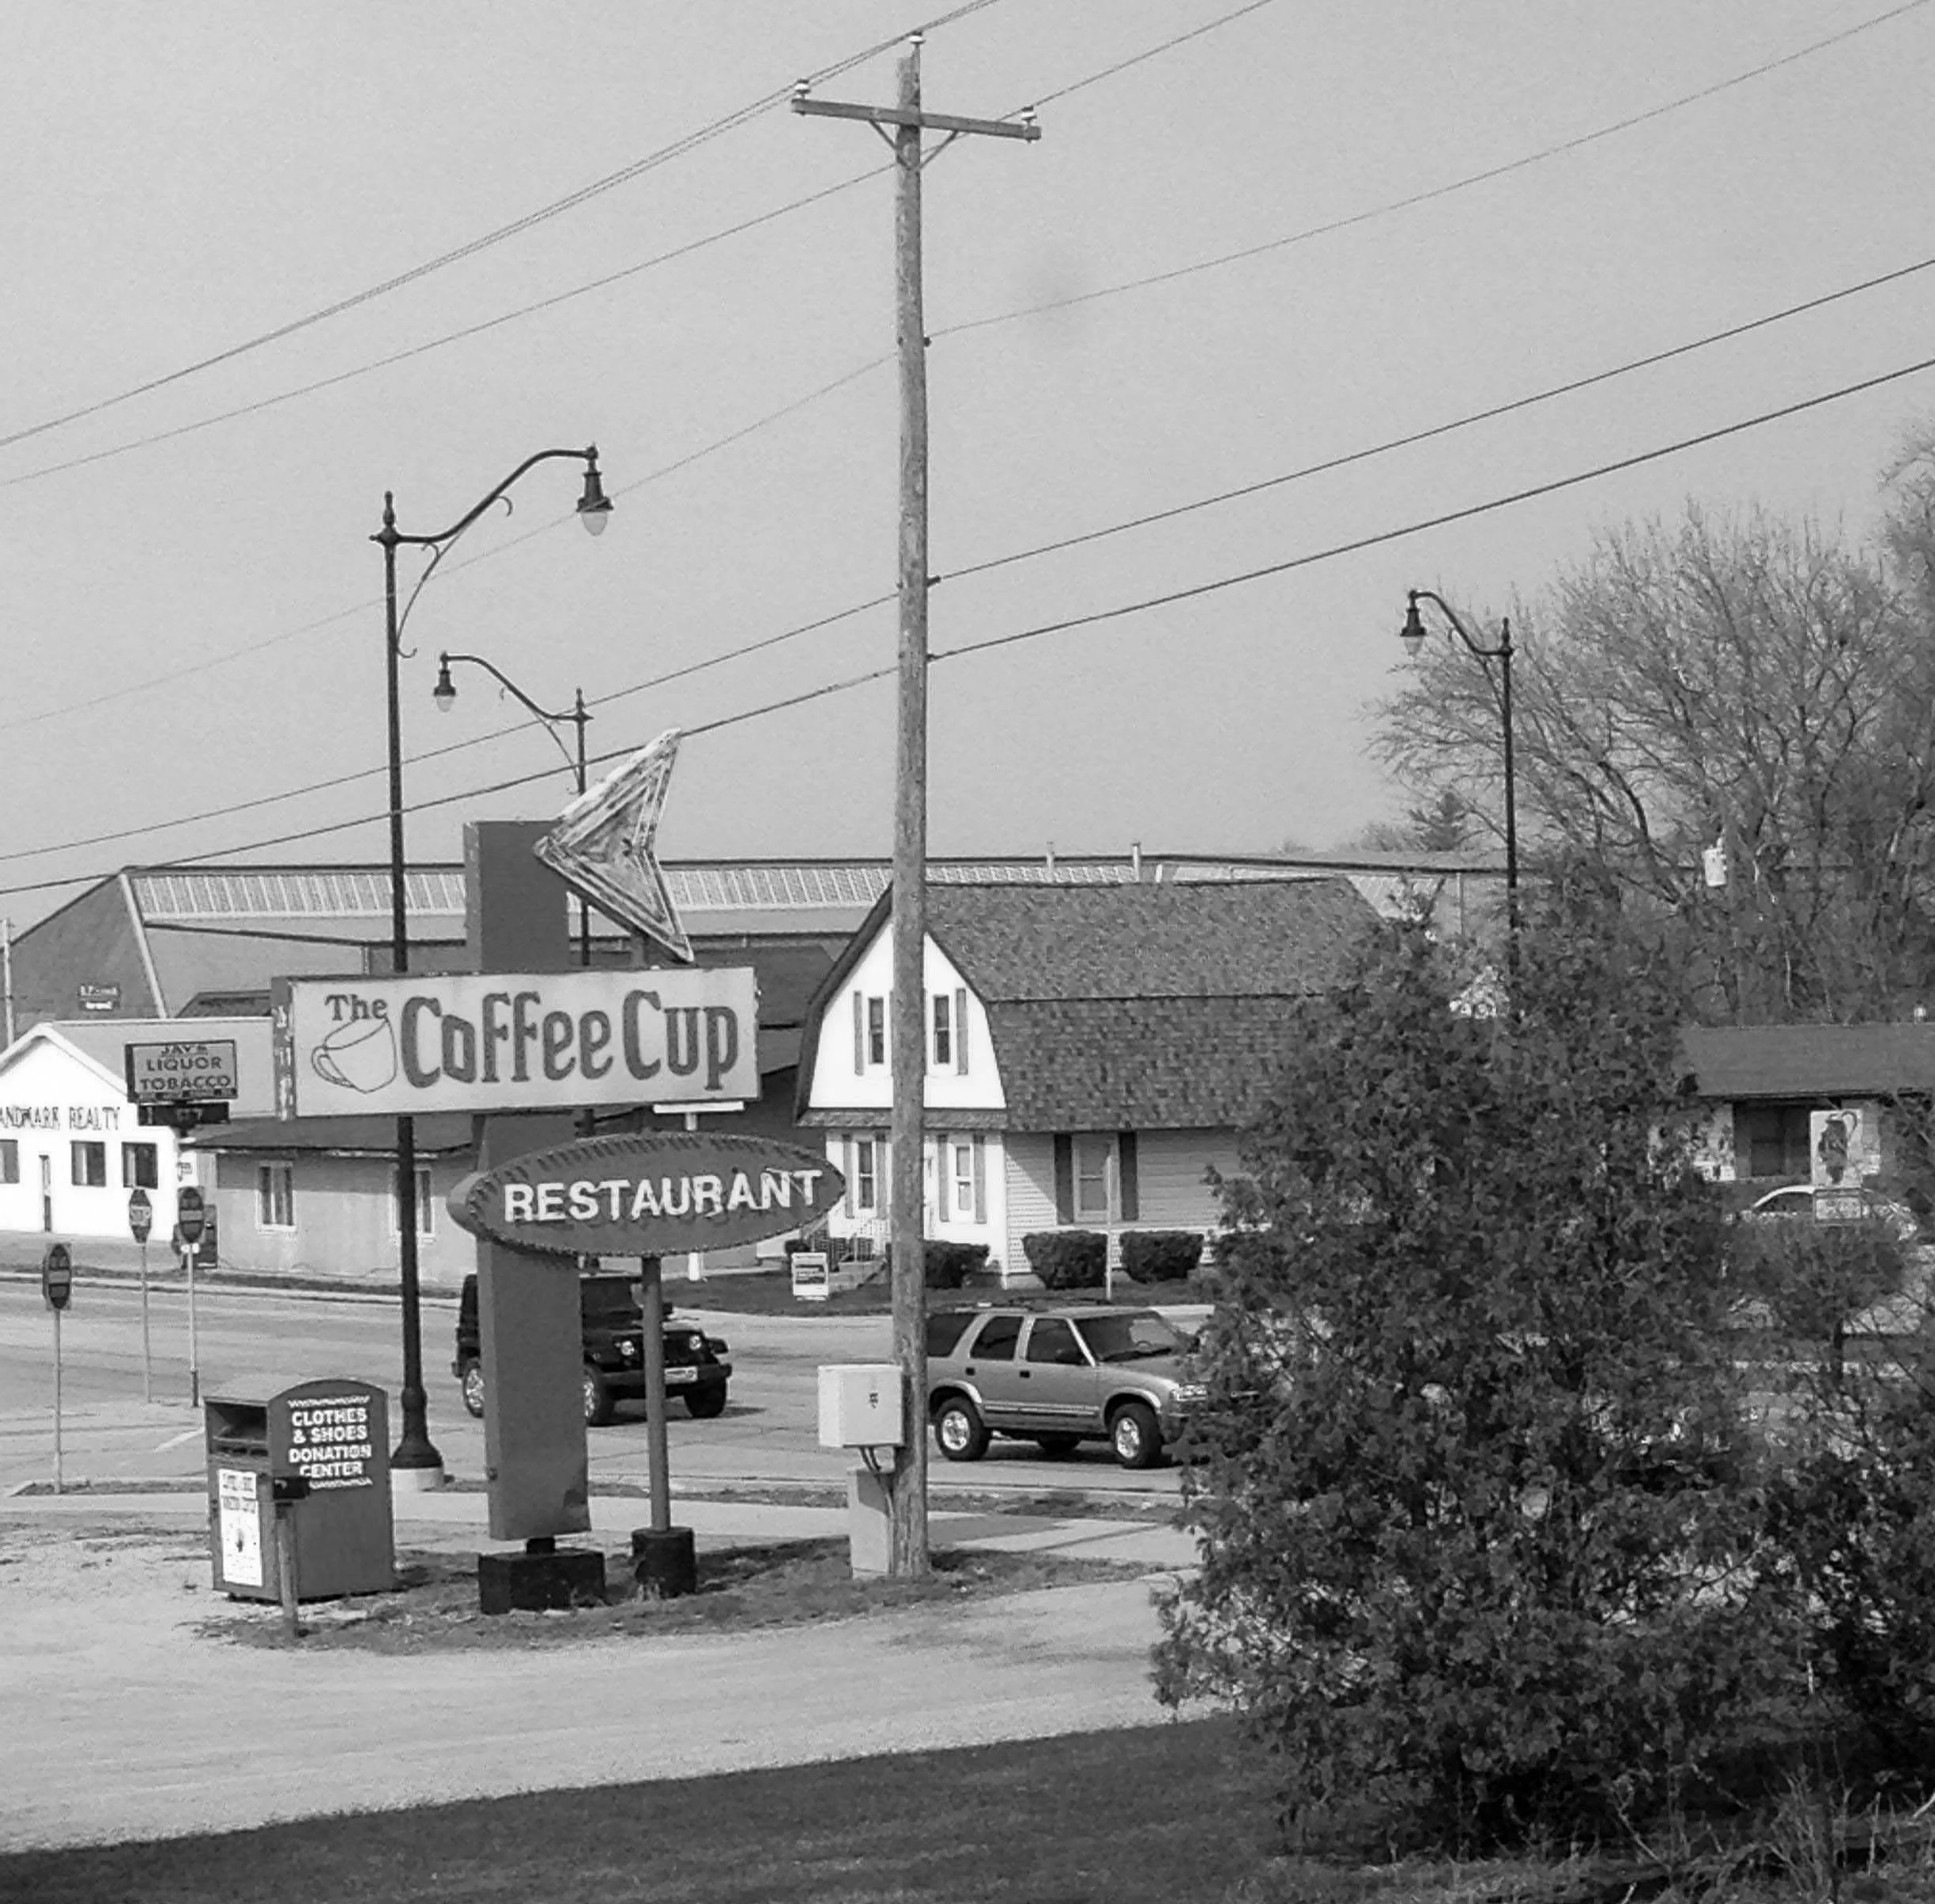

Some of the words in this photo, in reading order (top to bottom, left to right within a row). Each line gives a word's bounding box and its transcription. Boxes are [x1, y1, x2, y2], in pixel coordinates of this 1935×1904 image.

[325, 994, 388, 1021] The
[401, 991, 613, 1088] Coffee
[623, 990, 738, 1090] Cup
[146, 1057, 222, 1072] LIQUOR
[140, 1076, 231, 1090] TOBACCO
[69, 1106, 120, 1130] REALTY
[504, 1168, 822, 1222] RESTAURANT
[292, 1408, 368, 1426] CLOTHES
[292, 1429, 306, 1443] &
[311, 1425, 368, 1443] SHOES
[289, 1445, 372, 1463] DONATION
[300, 1461, 363, 1478] CENTER
